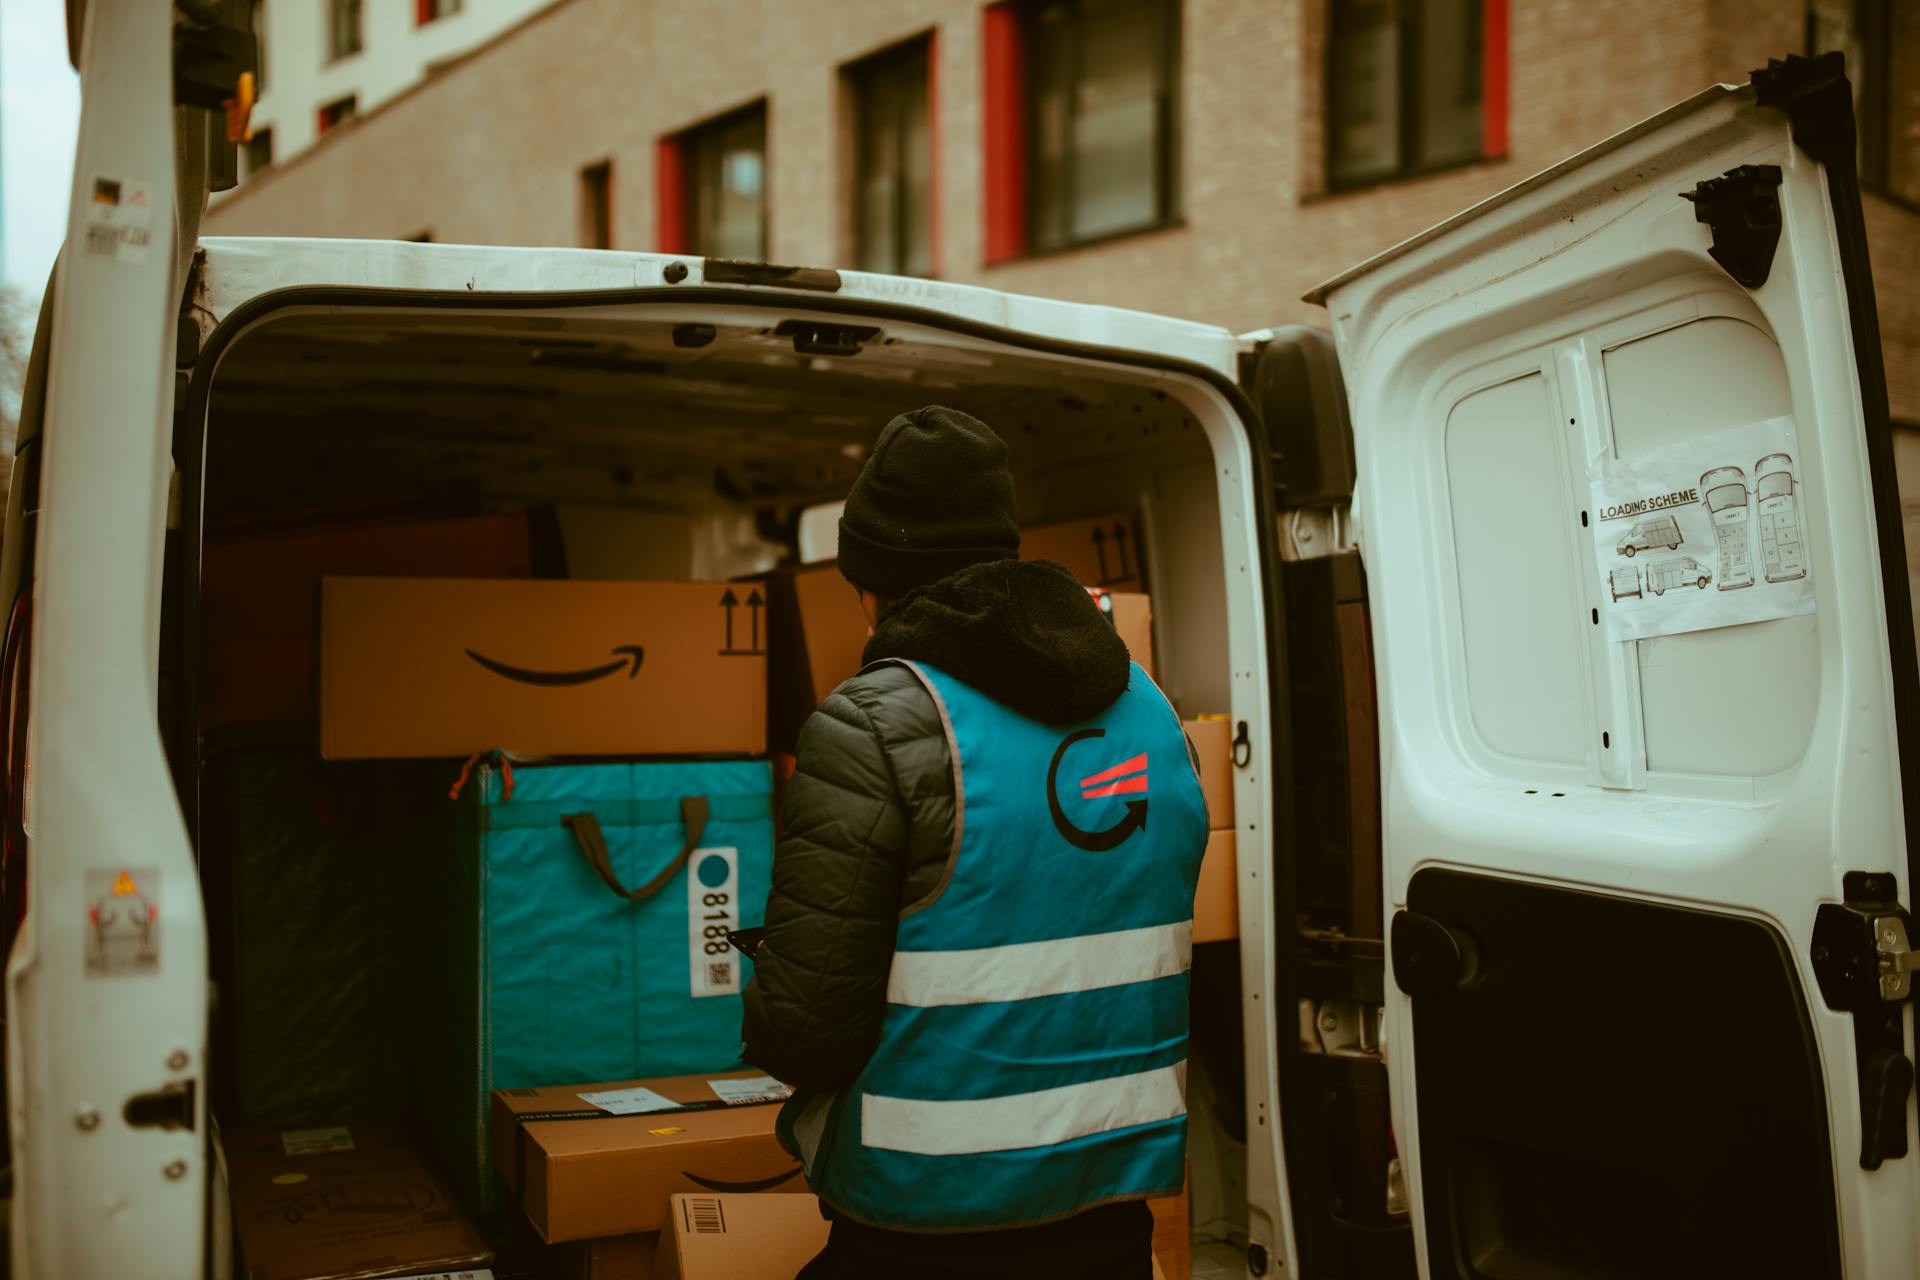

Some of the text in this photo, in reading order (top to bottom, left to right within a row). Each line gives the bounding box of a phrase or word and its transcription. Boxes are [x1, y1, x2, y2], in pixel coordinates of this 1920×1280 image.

[1600, 488, 1699, 519] LOADING SCHEME
[702, 892, 731, 956] 8188
